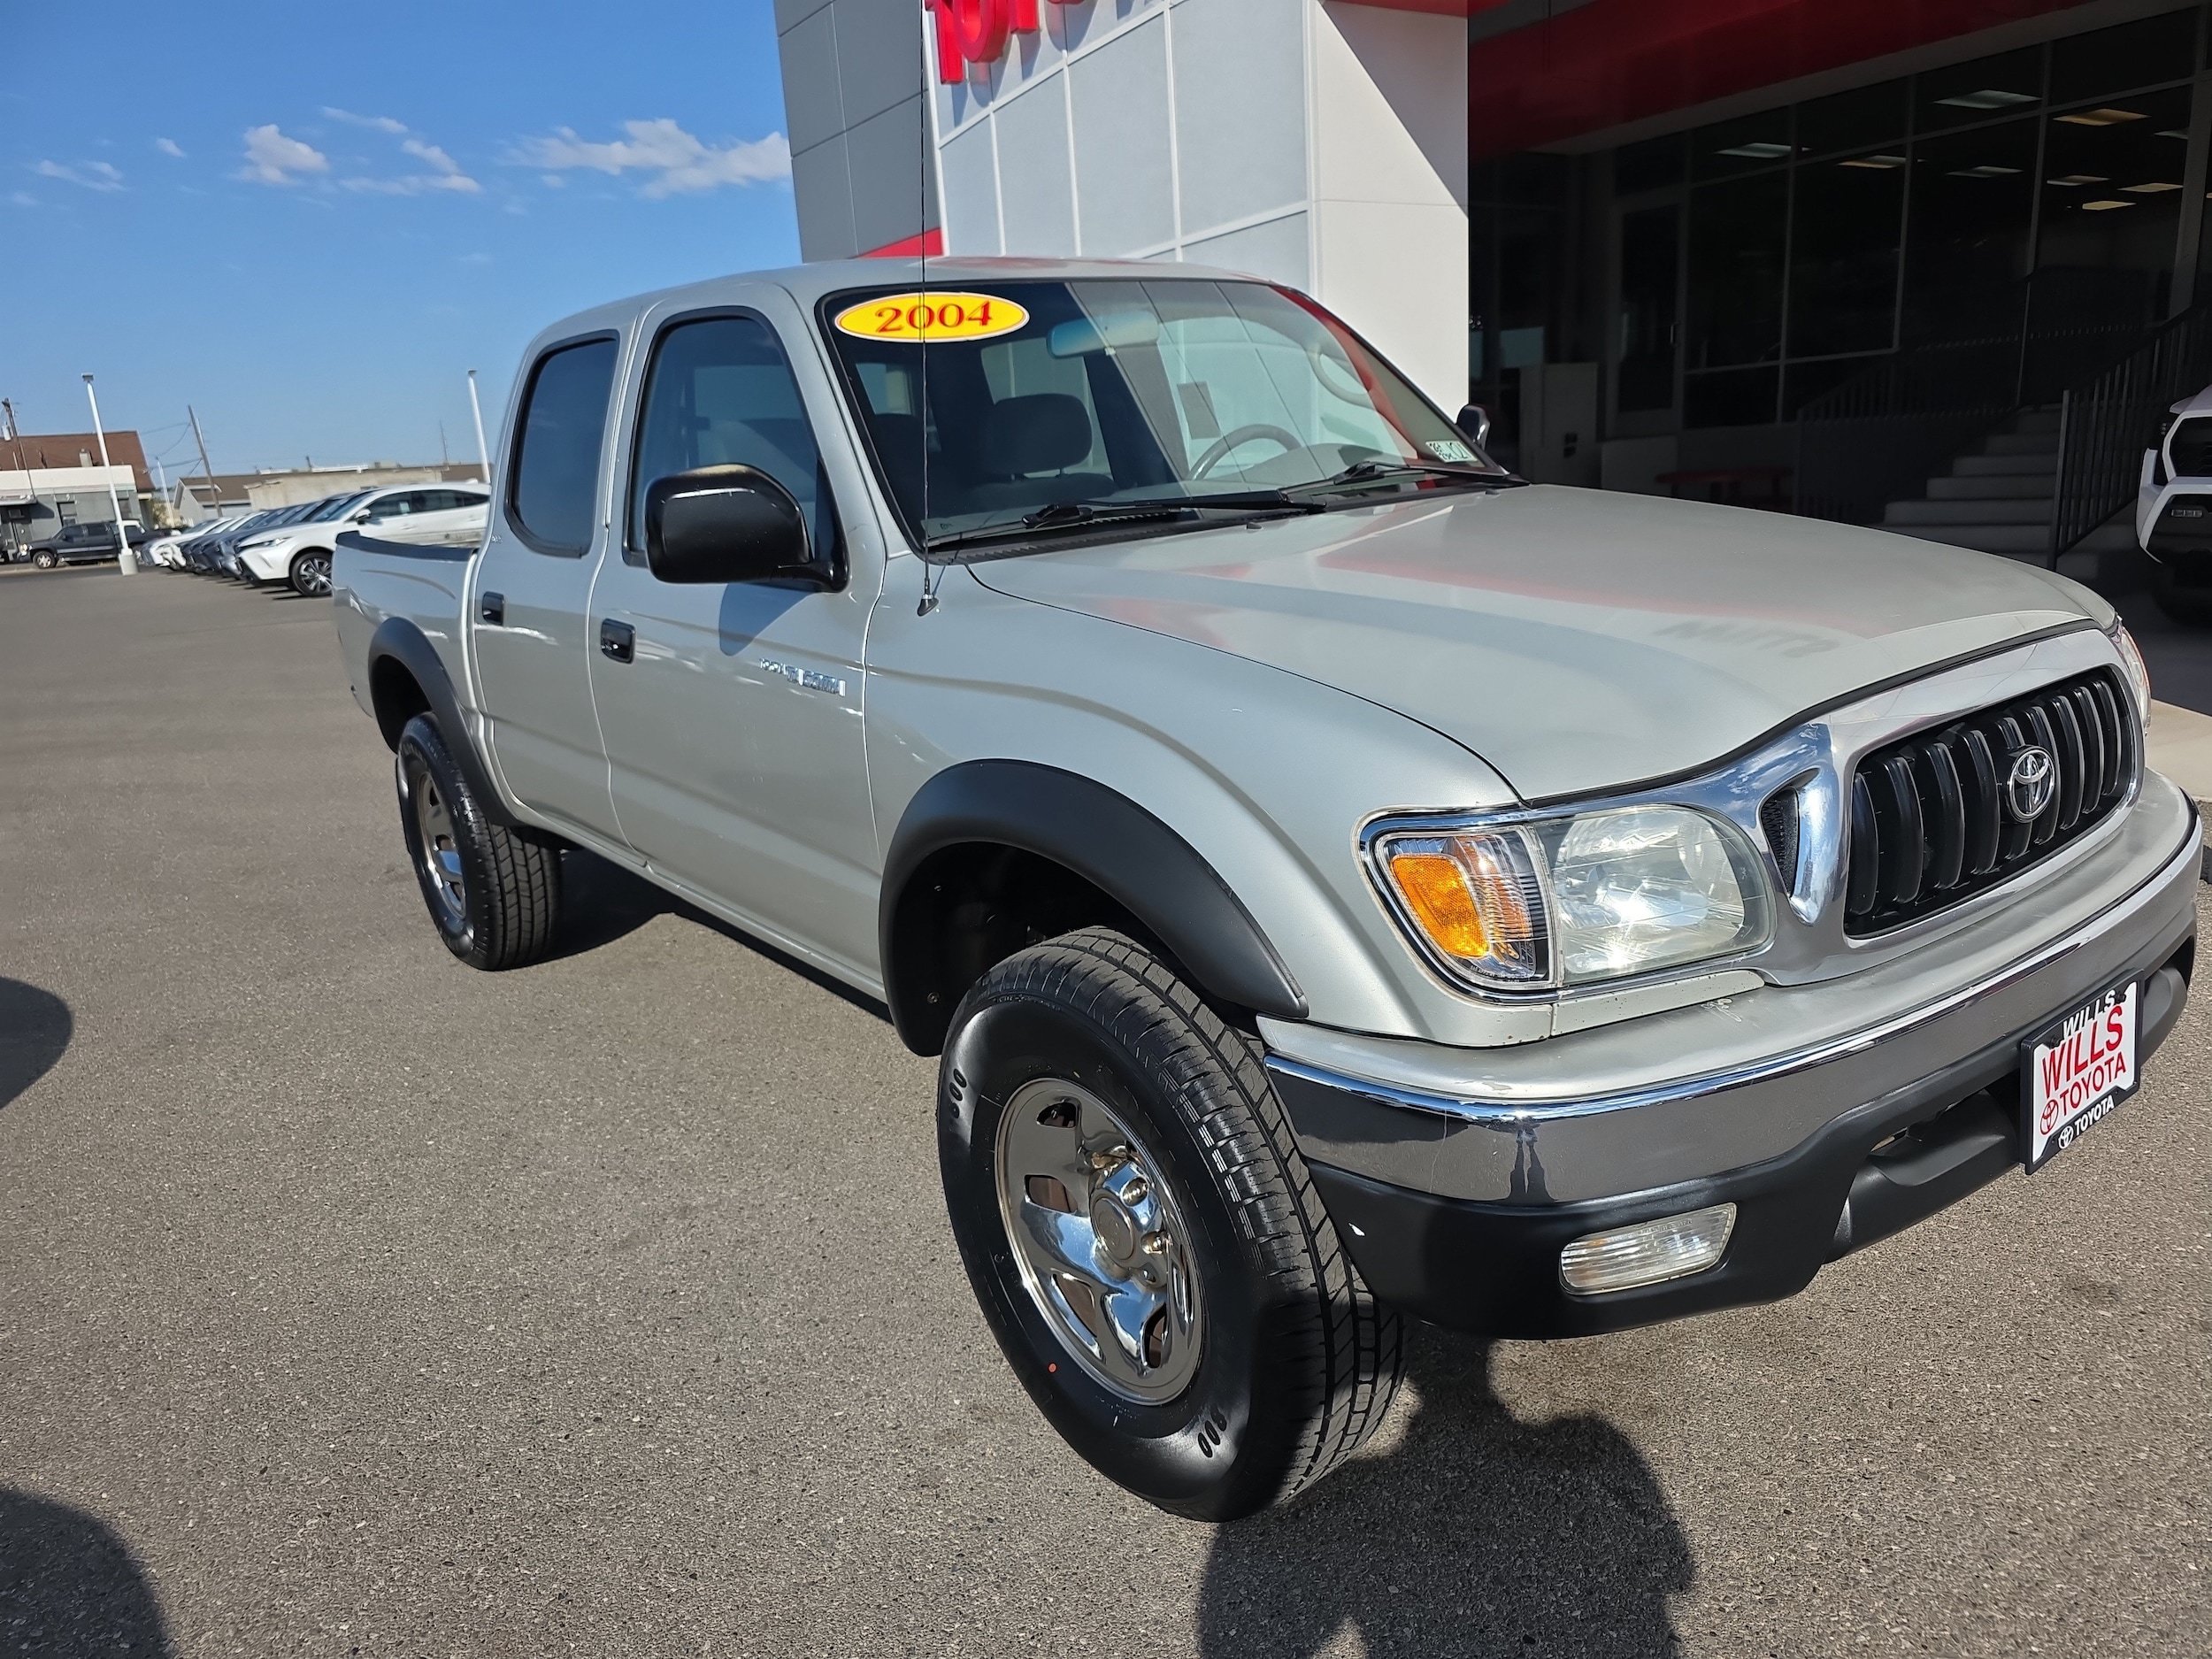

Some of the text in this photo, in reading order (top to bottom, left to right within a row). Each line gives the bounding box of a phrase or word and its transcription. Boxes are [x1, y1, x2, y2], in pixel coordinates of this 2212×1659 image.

[875, 300, 992, 334] 2004
[2062, 988, 2116, 1039] WILLS
[2042, 1005, 2124, 1099] WILLS
[2060, 1051, 2127, 1116] TOYOTA
[2074, 1094, 2115, 1136] TOYOTA
